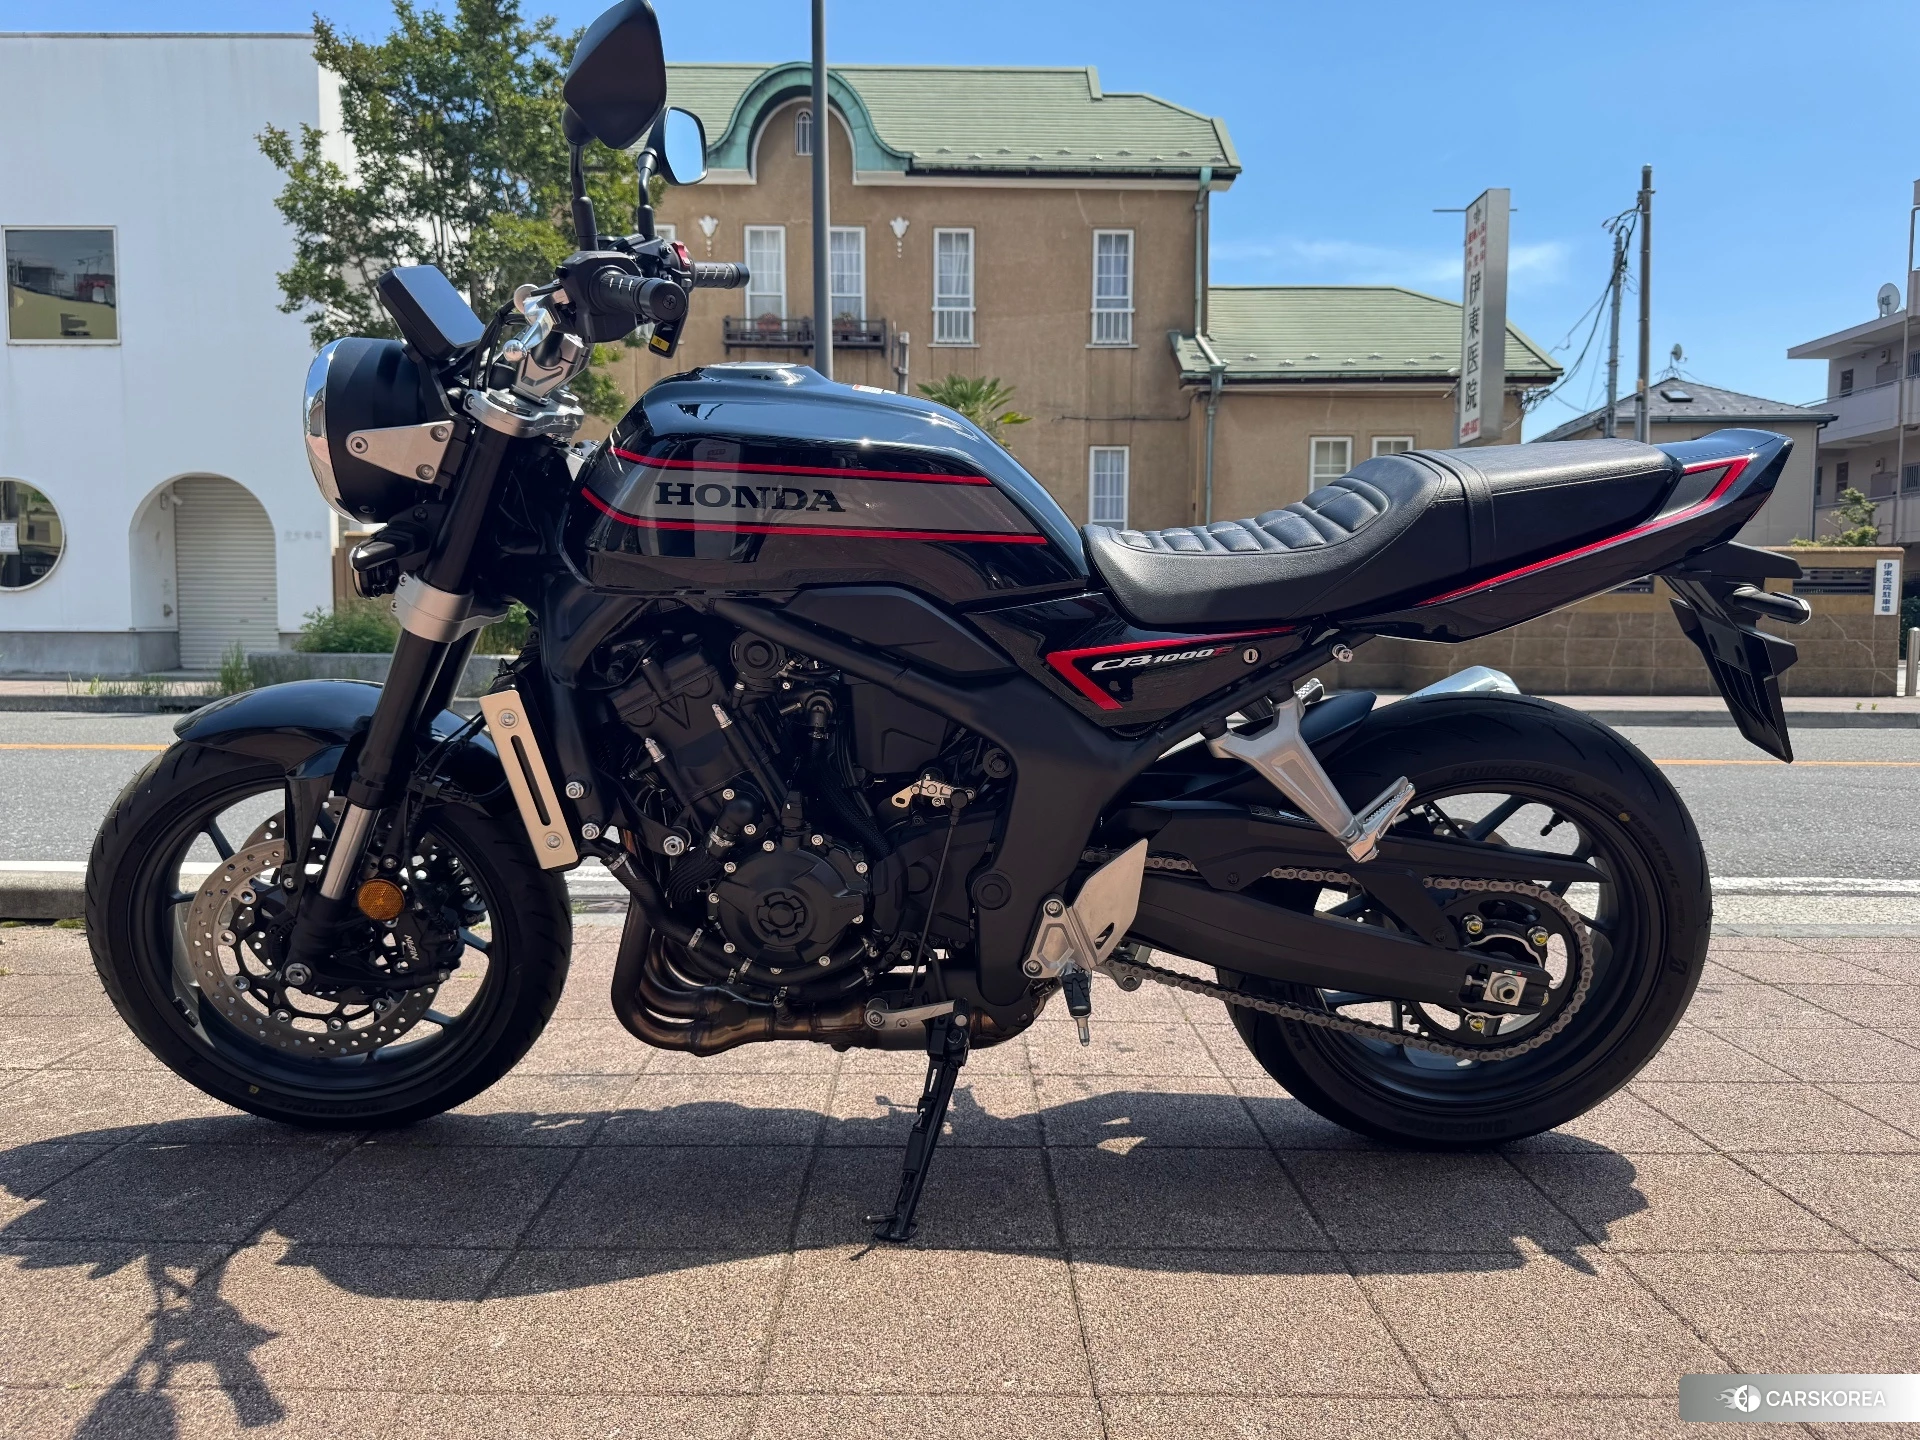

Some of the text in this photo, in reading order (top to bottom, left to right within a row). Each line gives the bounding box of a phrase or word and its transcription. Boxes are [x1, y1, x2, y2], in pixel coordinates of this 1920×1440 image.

[1464, 270, 1481, 413] 伊東医院
[655, 481, 846, 513] HONDA
[1881, 562, 1893, 612] 伊東医院駐車場
[1091, 646, 1234, 671] CB1000F
